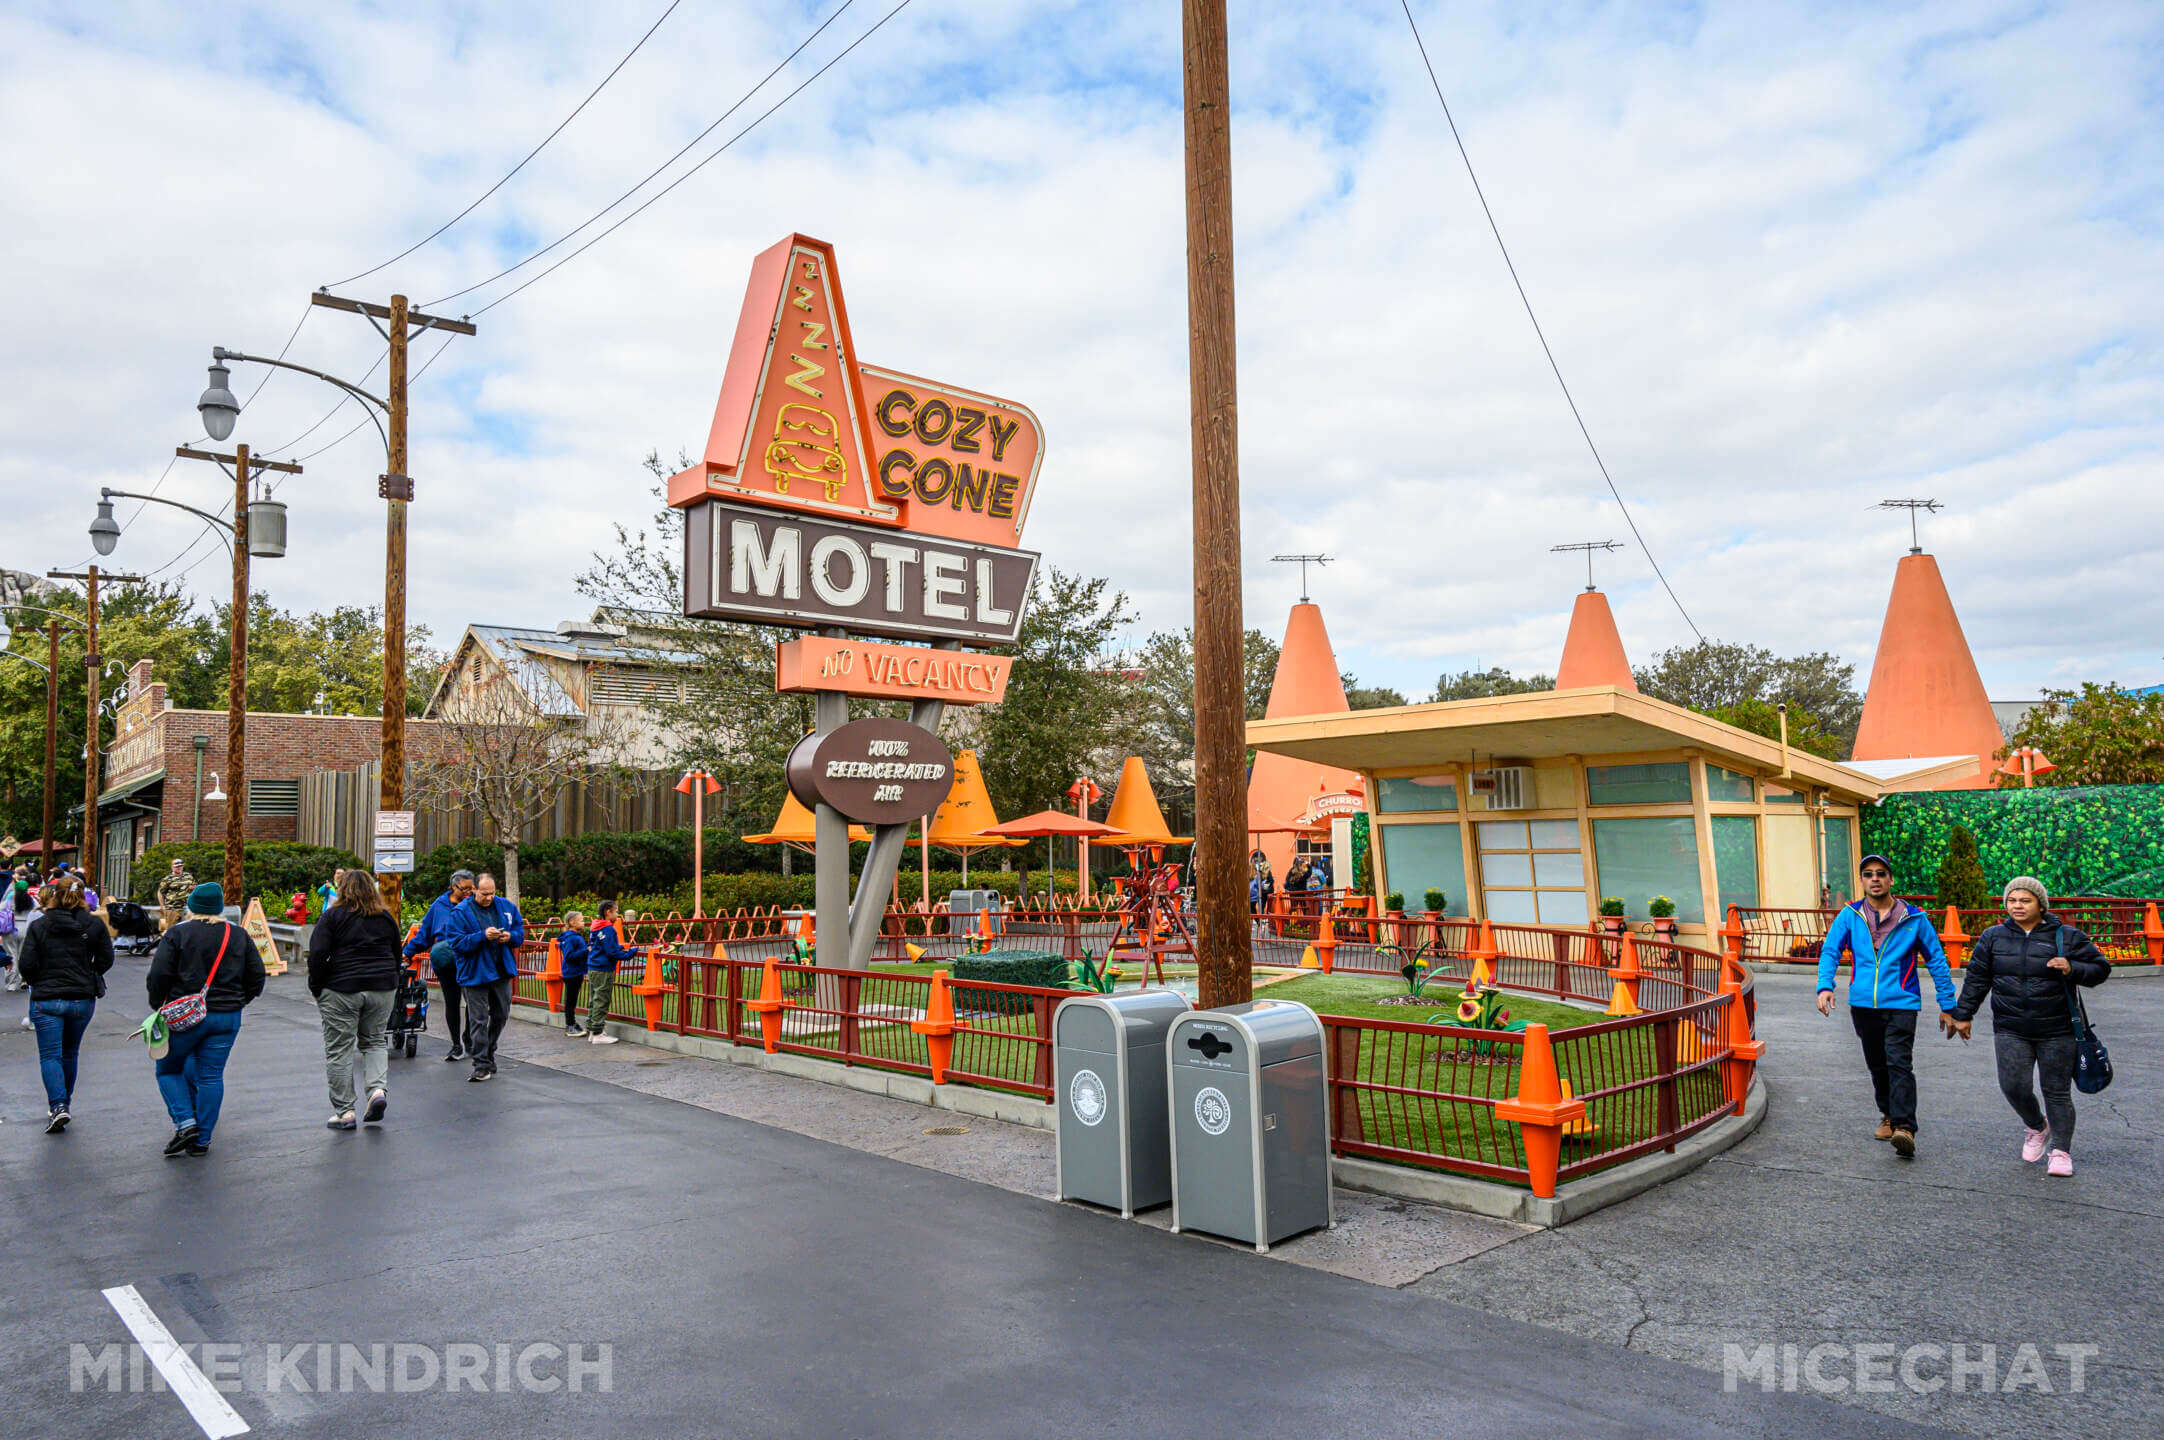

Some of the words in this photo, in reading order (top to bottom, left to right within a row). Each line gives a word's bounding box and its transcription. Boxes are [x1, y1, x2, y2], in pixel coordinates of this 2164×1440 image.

[876, 388, 1020, 461] COZY
[878, 448, 1021, 519] CONE
[730, 518, 1014, 626] MOTEL
[821, 649, 854, 678] NO
[864, 652, 1000, 693] VACANCY
[825, 760, 946, 780] REFRIGERATED
[868, 740, 909, 757] 100%
[873, 784, 903, 801] AIR
